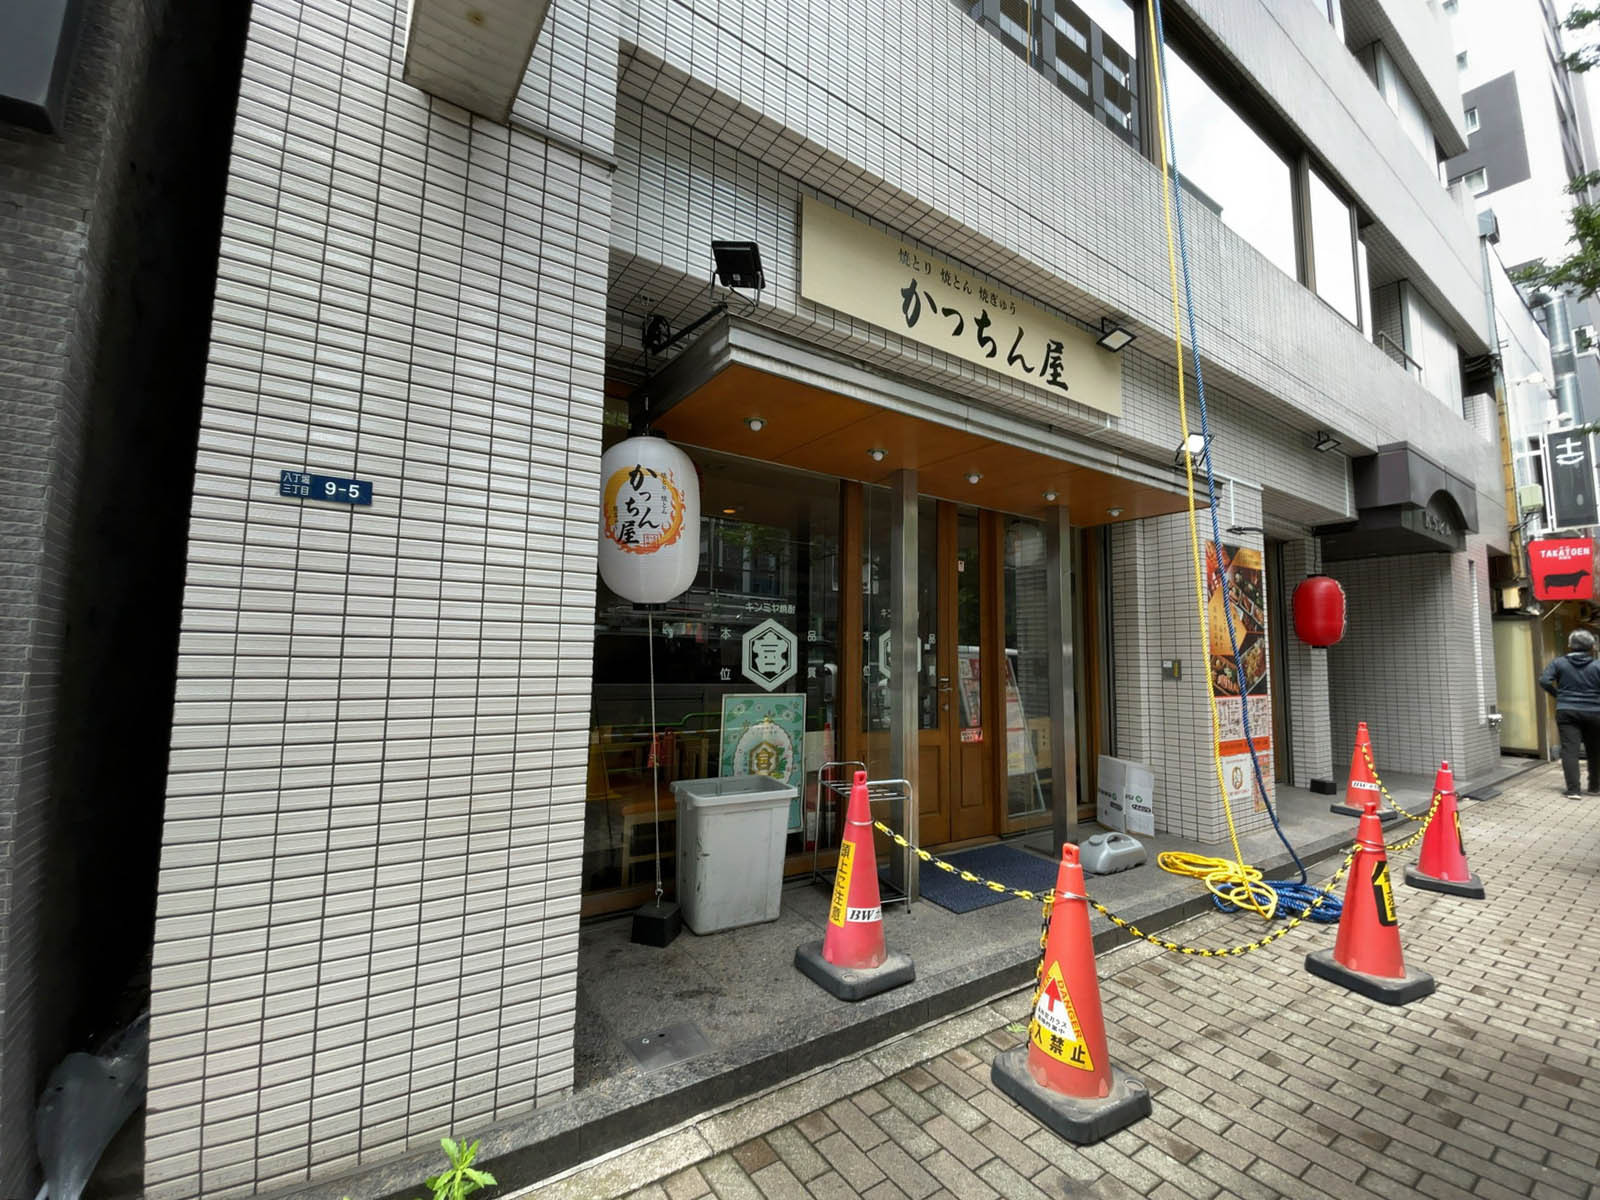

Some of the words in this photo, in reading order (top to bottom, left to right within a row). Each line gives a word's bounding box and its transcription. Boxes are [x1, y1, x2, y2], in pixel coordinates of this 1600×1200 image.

[901, 278, 1069, 391] かっちん屋
[325, 481, 360, 498] 9-5
[618, 464, 660, 545] かっちん屋
[745, 602, 796, 614] キンミヤ焼酎
[849, 909, 874, 921] BW
[1057, 979, 1082, 1039] DANGER
